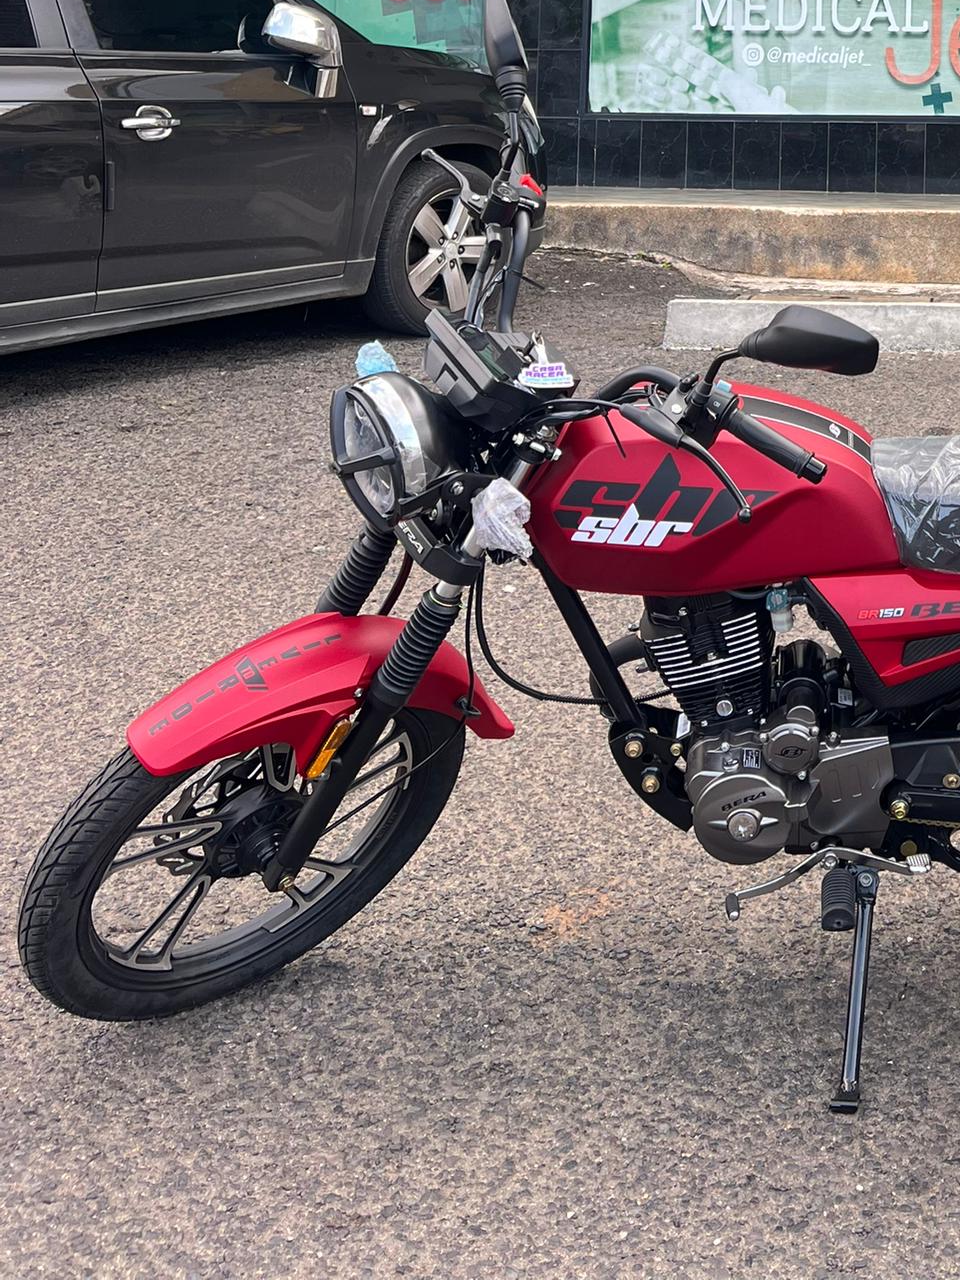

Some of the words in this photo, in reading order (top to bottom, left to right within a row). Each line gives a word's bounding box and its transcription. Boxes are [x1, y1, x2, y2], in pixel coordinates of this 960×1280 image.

[571, 503, 694, 548] sbr
[858, 607, 905, 620] BR150
[721, 791, 767, 812] BERA
